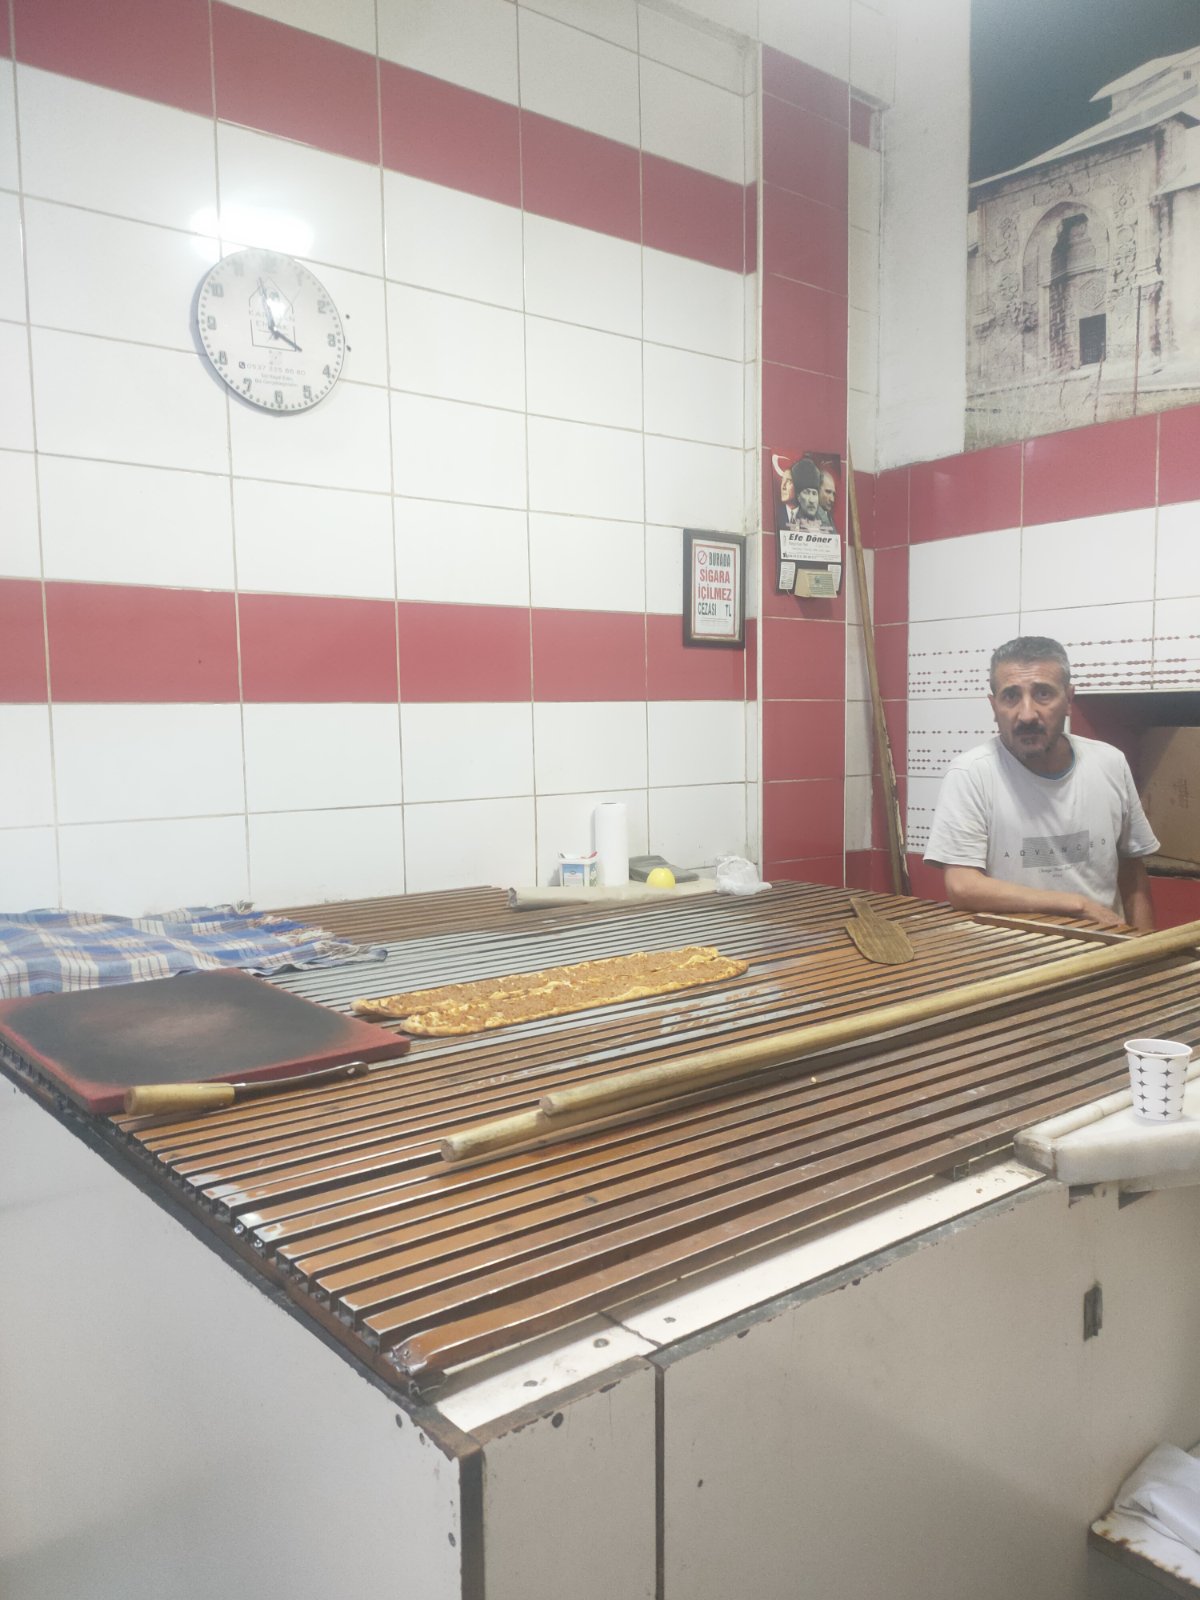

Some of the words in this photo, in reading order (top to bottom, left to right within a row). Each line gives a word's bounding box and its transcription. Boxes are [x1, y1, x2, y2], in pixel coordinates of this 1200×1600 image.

[211, 283, 224, 298] 10
[317, 300, 328, 314] 2
[207, 315, 217, 330] 9
[327, 333, 337, 348] 3
[219, 350, 228, 365] 8
[322, 364, 332, 379] 4
[243, 378, 252, 393] 7
[302, 385, 312, 400] 5
[274, 390, 284, 405] 6
[788, 533, 804, 541] Efe
[805, 534, 833, 543] Döner
[708, 551, 731, 568] BURADA
[699, 566, 731, 584] SİGARA
[698, 583, 732, 602] İÇİLMEZ
[697, 602, 717, 616] CEZASI
[725, 604, 732, 617] TL
